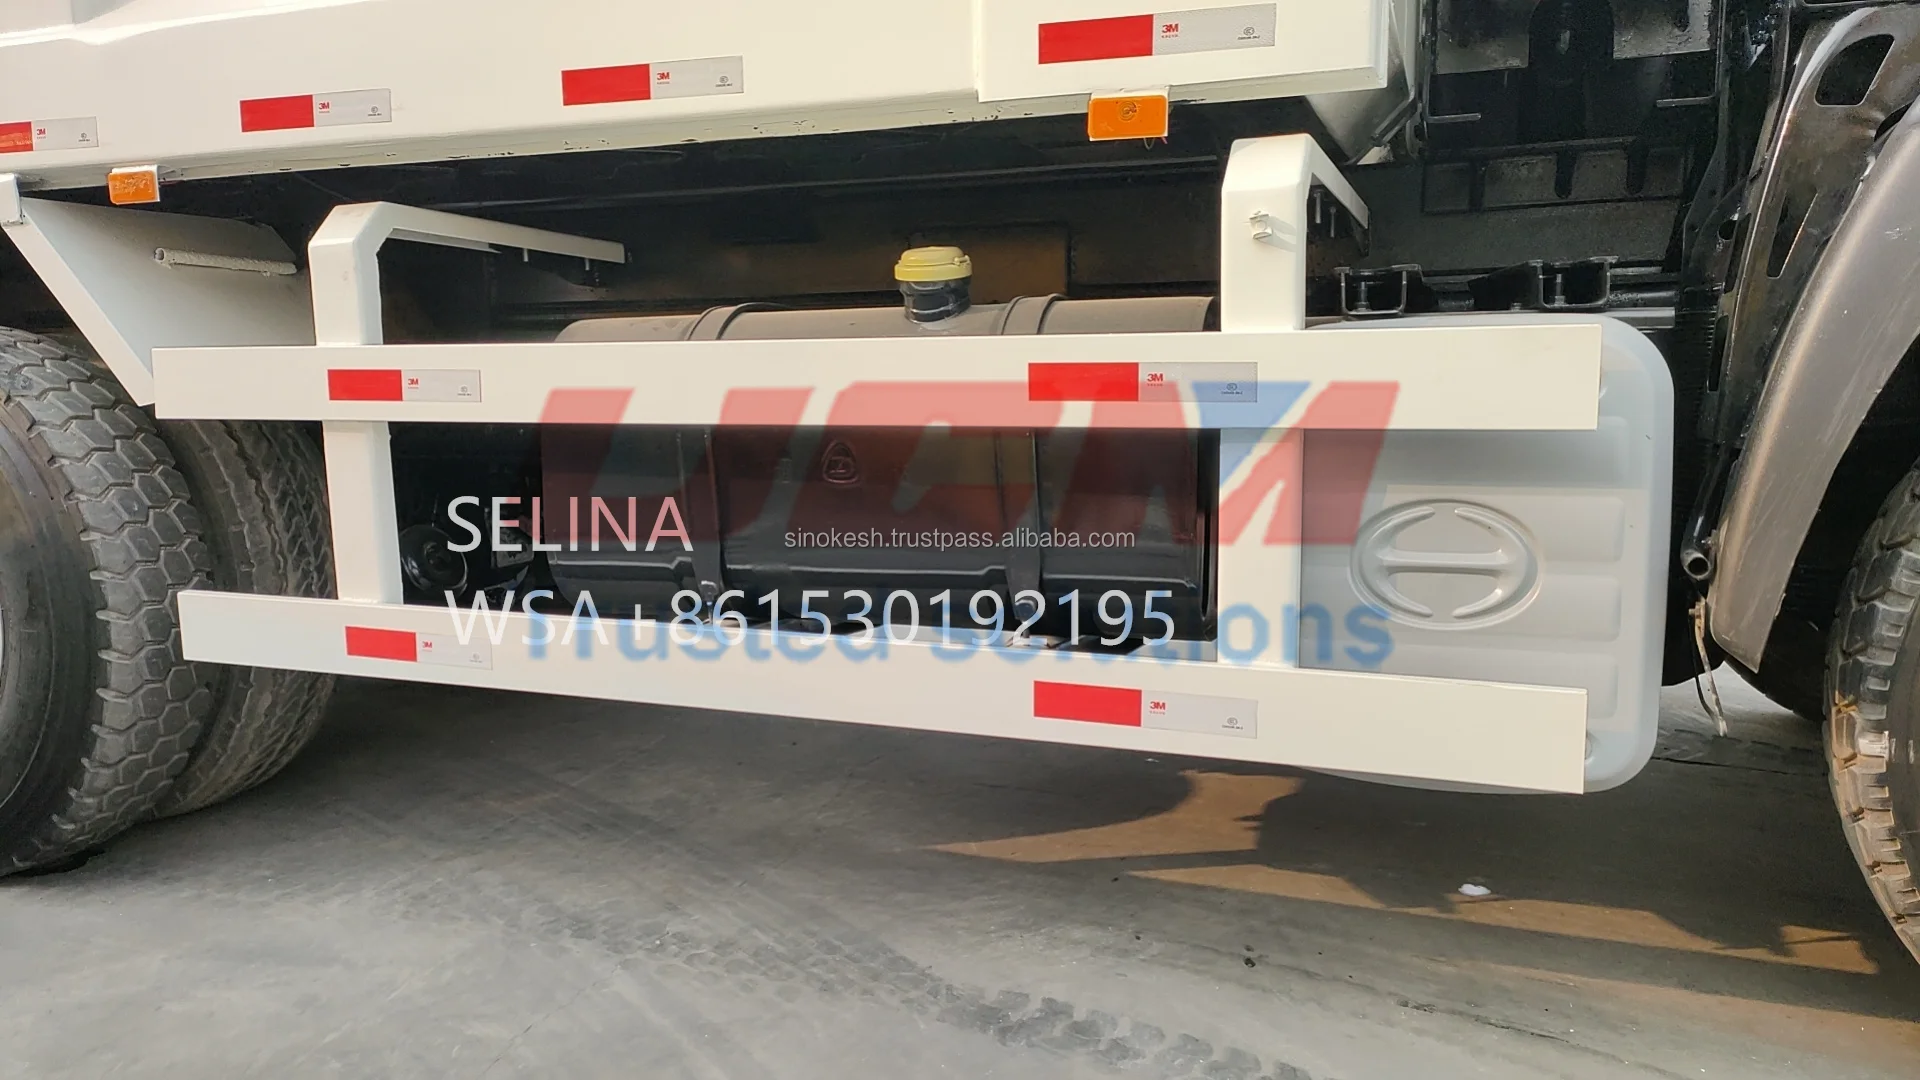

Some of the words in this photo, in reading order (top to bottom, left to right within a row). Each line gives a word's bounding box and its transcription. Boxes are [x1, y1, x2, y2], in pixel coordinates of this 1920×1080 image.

[1161, 23, 1179, 34] 3M
[656, 72, 670, 81] 3M
[318, 102, 330, 110] 3M
[36, 128, 46, 136] 3M
[407, 378, 419, 386] 3M
[1147, 373, 1164, 382] 3M
[1150, 701, 1166, 711] 3M
